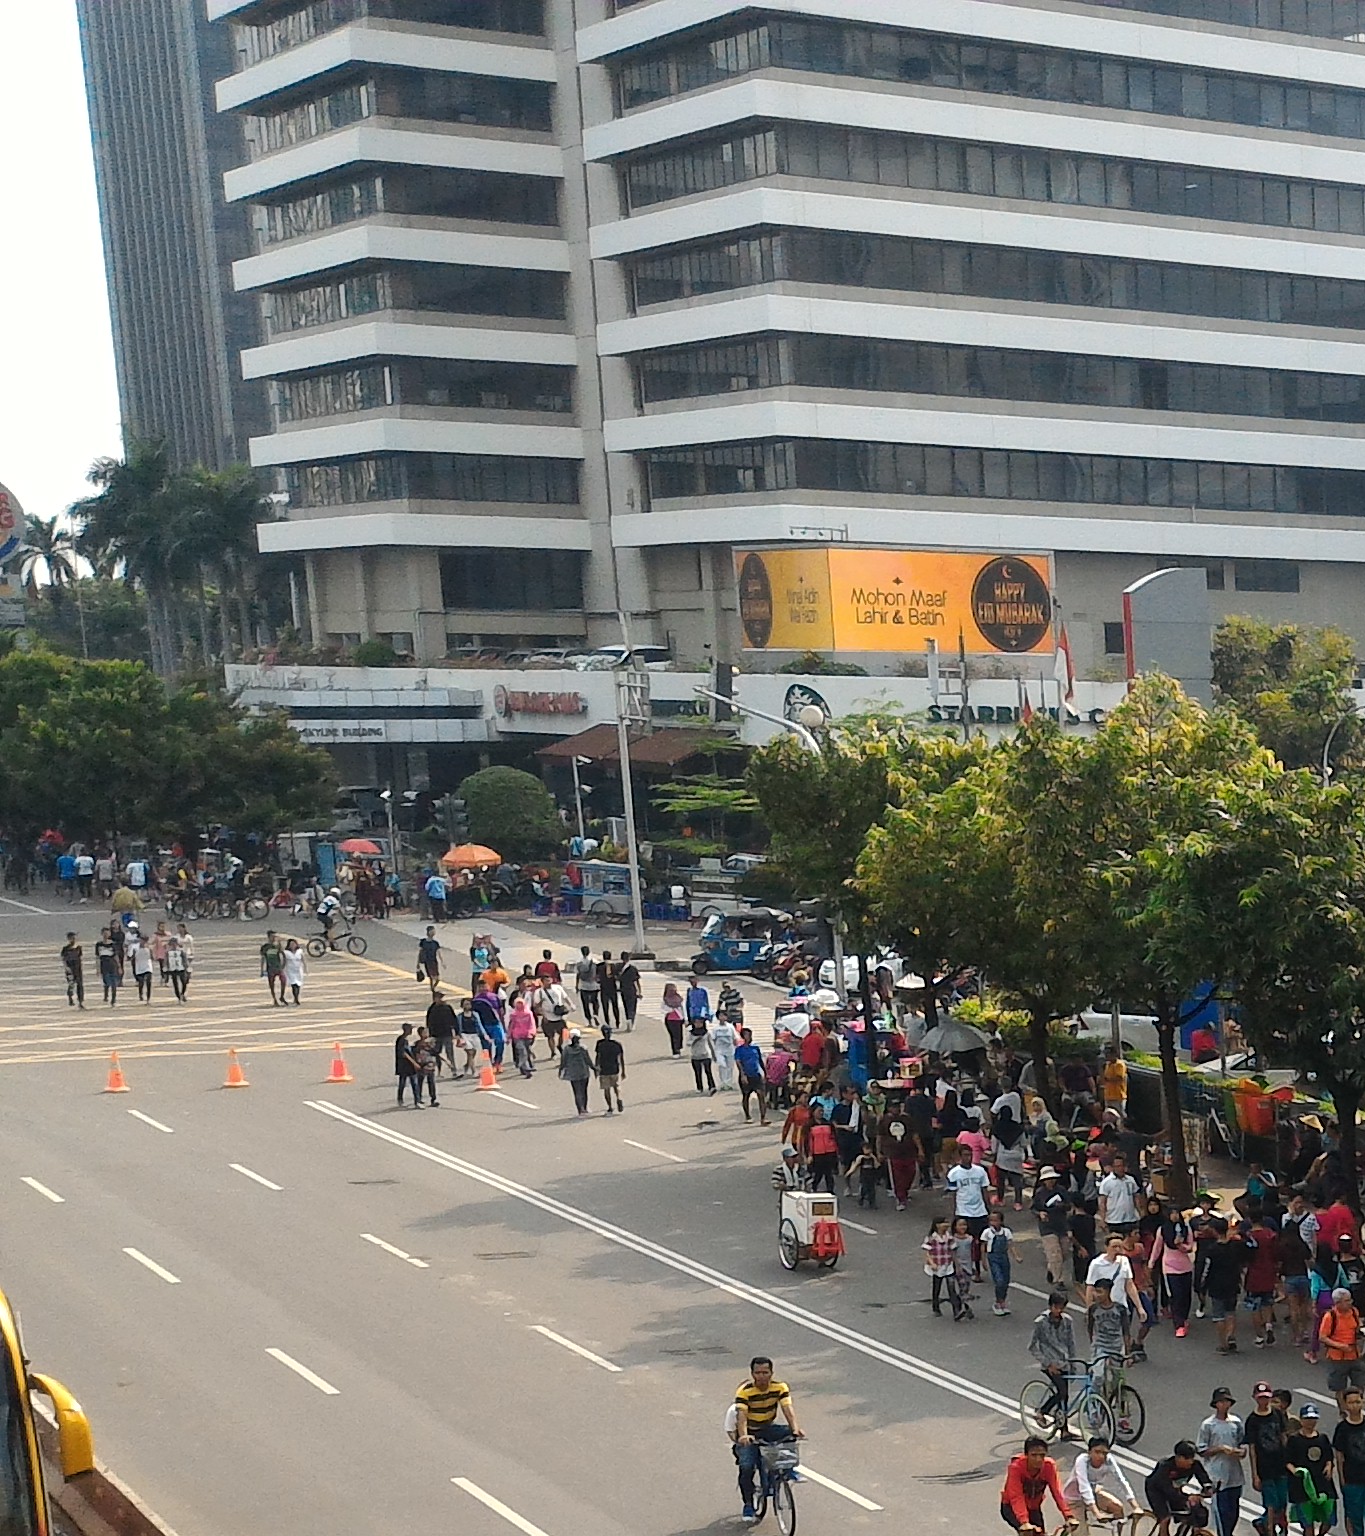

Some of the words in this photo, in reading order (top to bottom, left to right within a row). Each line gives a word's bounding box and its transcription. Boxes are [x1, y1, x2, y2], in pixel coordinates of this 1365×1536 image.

[851, 588, 905, 607] Mohon
[910, 589, 948, 608] Maaf
[994, 582, 1025, 602] HAPPY
[856, 607, 888, 624] Lahir
[892, 609, 904, 624] &
[909, 608, 946, 626] Batin
[978, 602, 995, 624] EID
[996, 603, 1045, 624] MUBARAK
